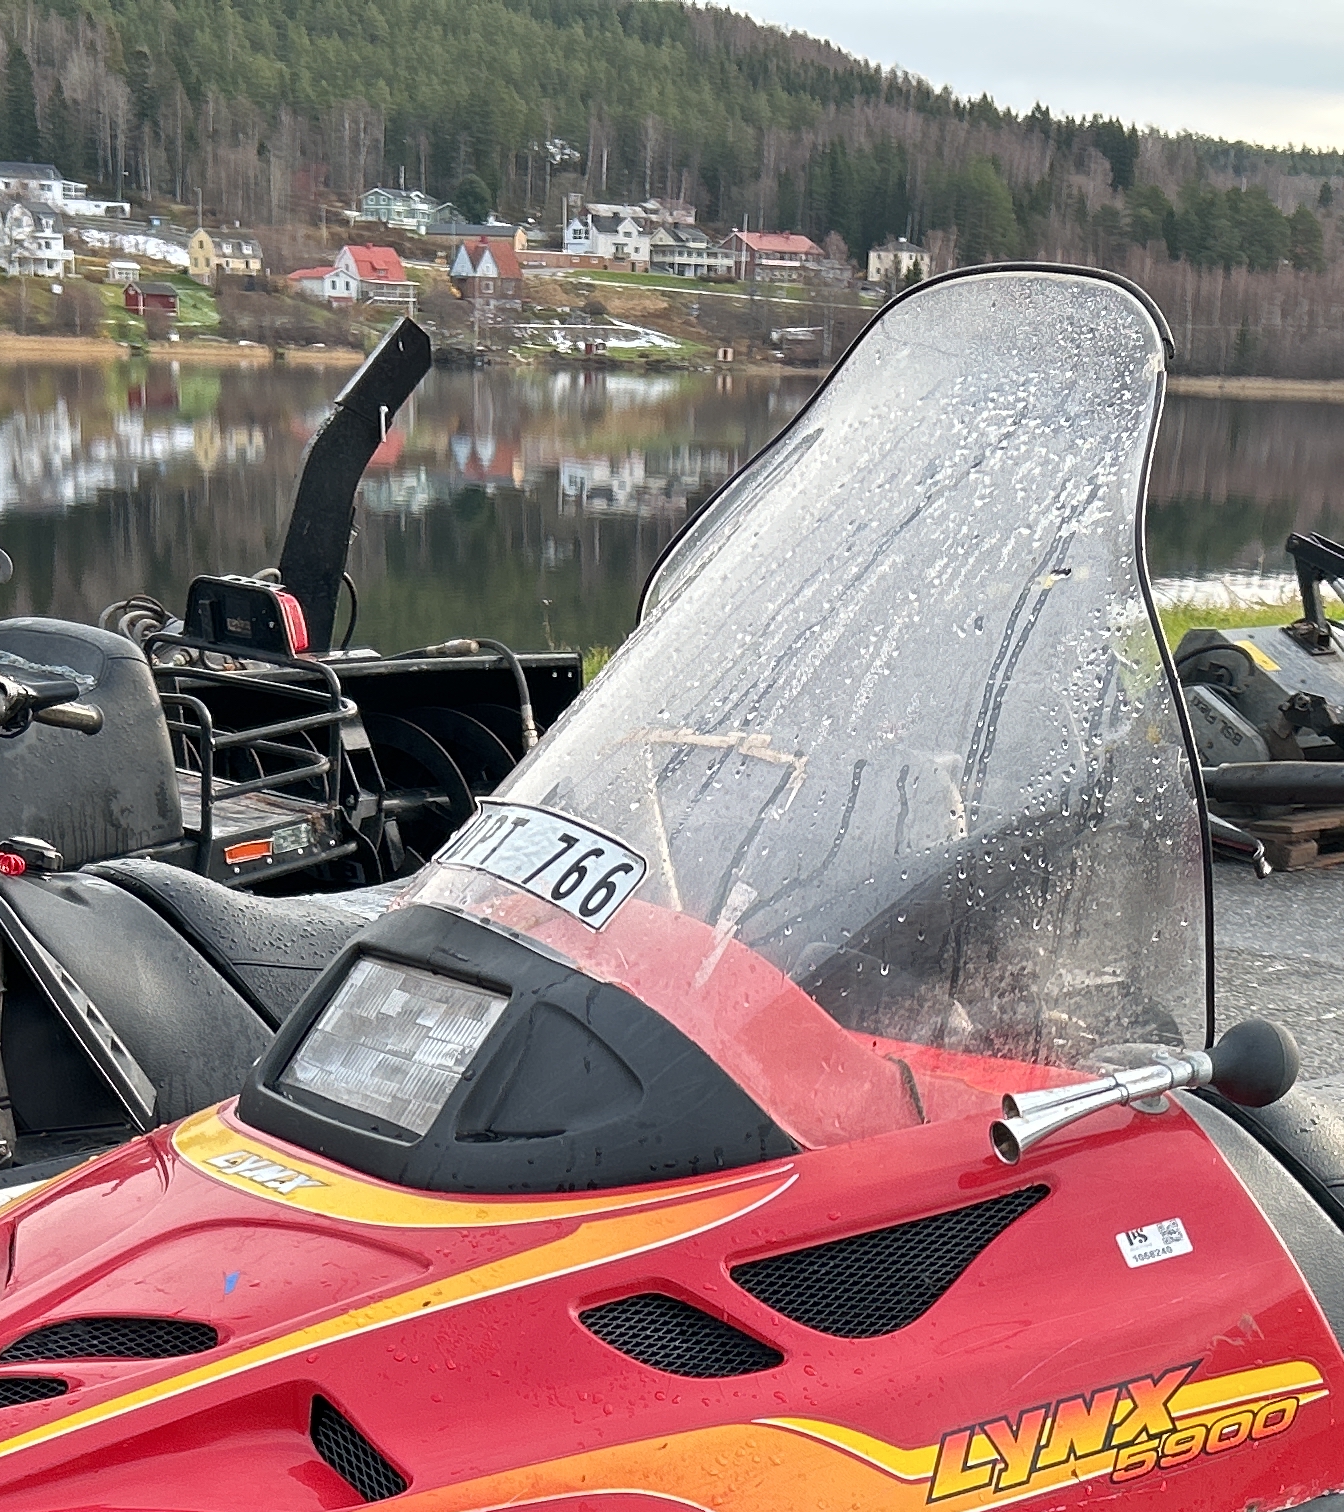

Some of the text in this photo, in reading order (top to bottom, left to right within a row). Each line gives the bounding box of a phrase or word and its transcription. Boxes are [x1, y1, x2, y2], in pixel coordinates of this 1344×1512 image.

[520, 832, 635, 918] 766
[202, 1149, 331, 1196] LYNX
[926, 1359, 1205, 1504] LYNX
[1110, 1396, 1301, 1485] 5900
